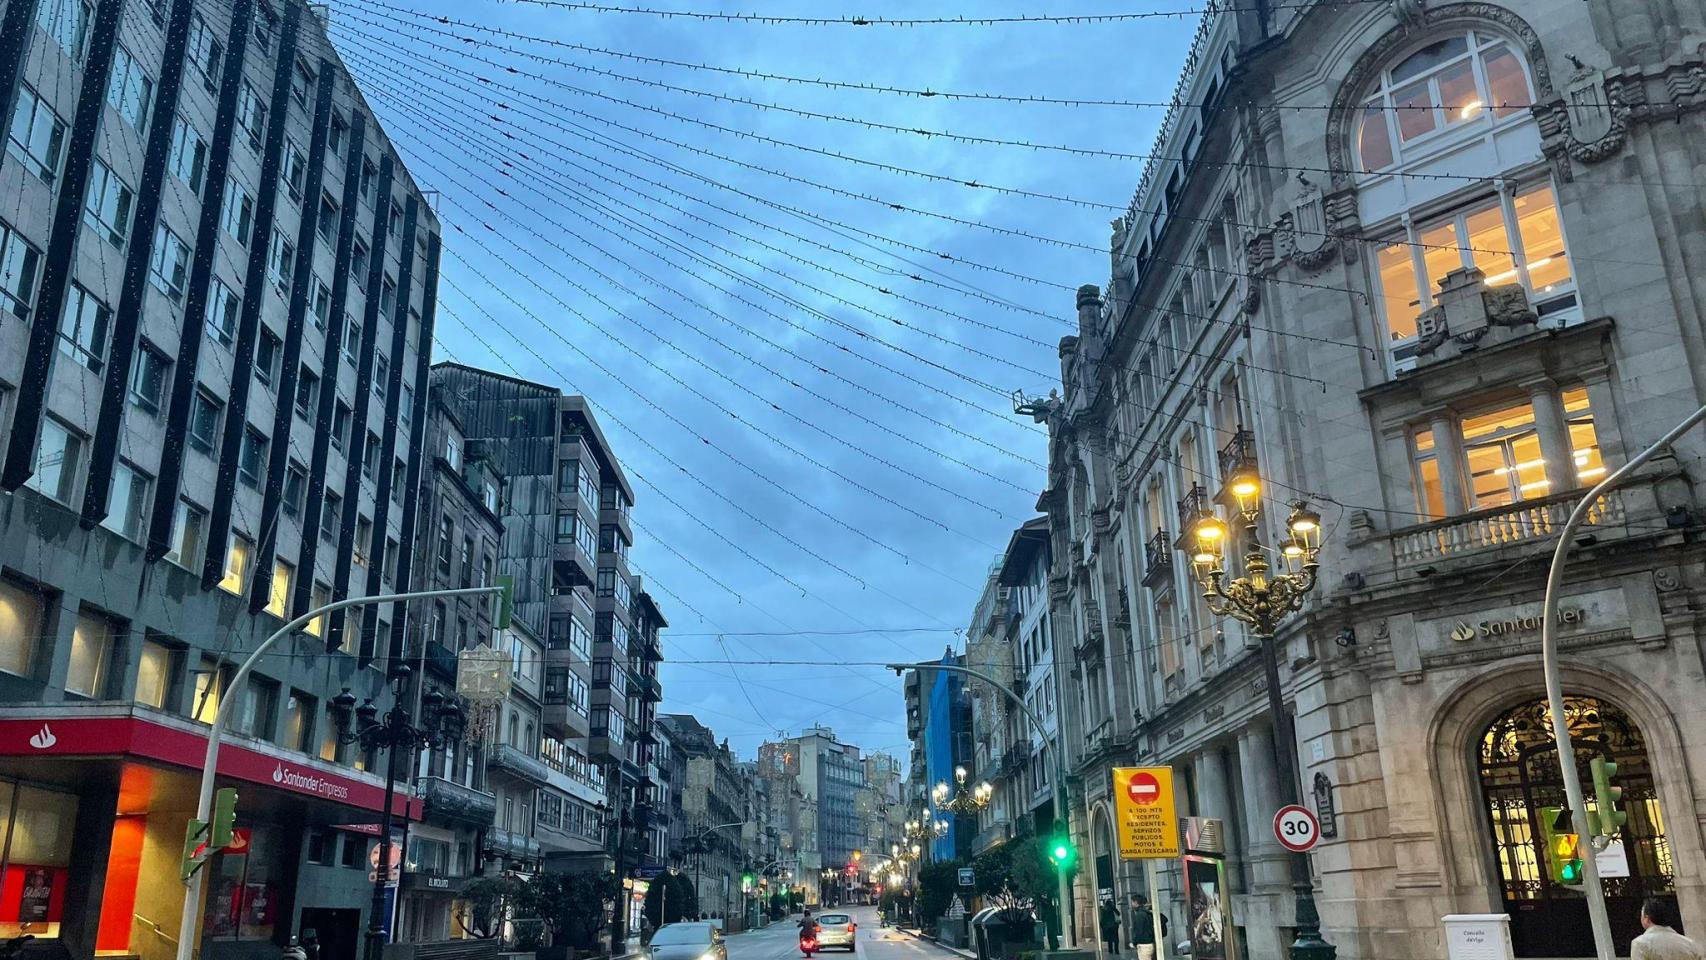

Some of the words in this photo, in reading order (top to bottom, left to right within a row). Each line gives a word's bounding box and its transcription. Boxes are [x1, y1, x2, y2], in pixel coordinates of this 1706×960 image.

[282, 768, 319, 792] Santander
[319, 778, 349, 798] Empresas
[1284, 820, 1309, 836] 30
